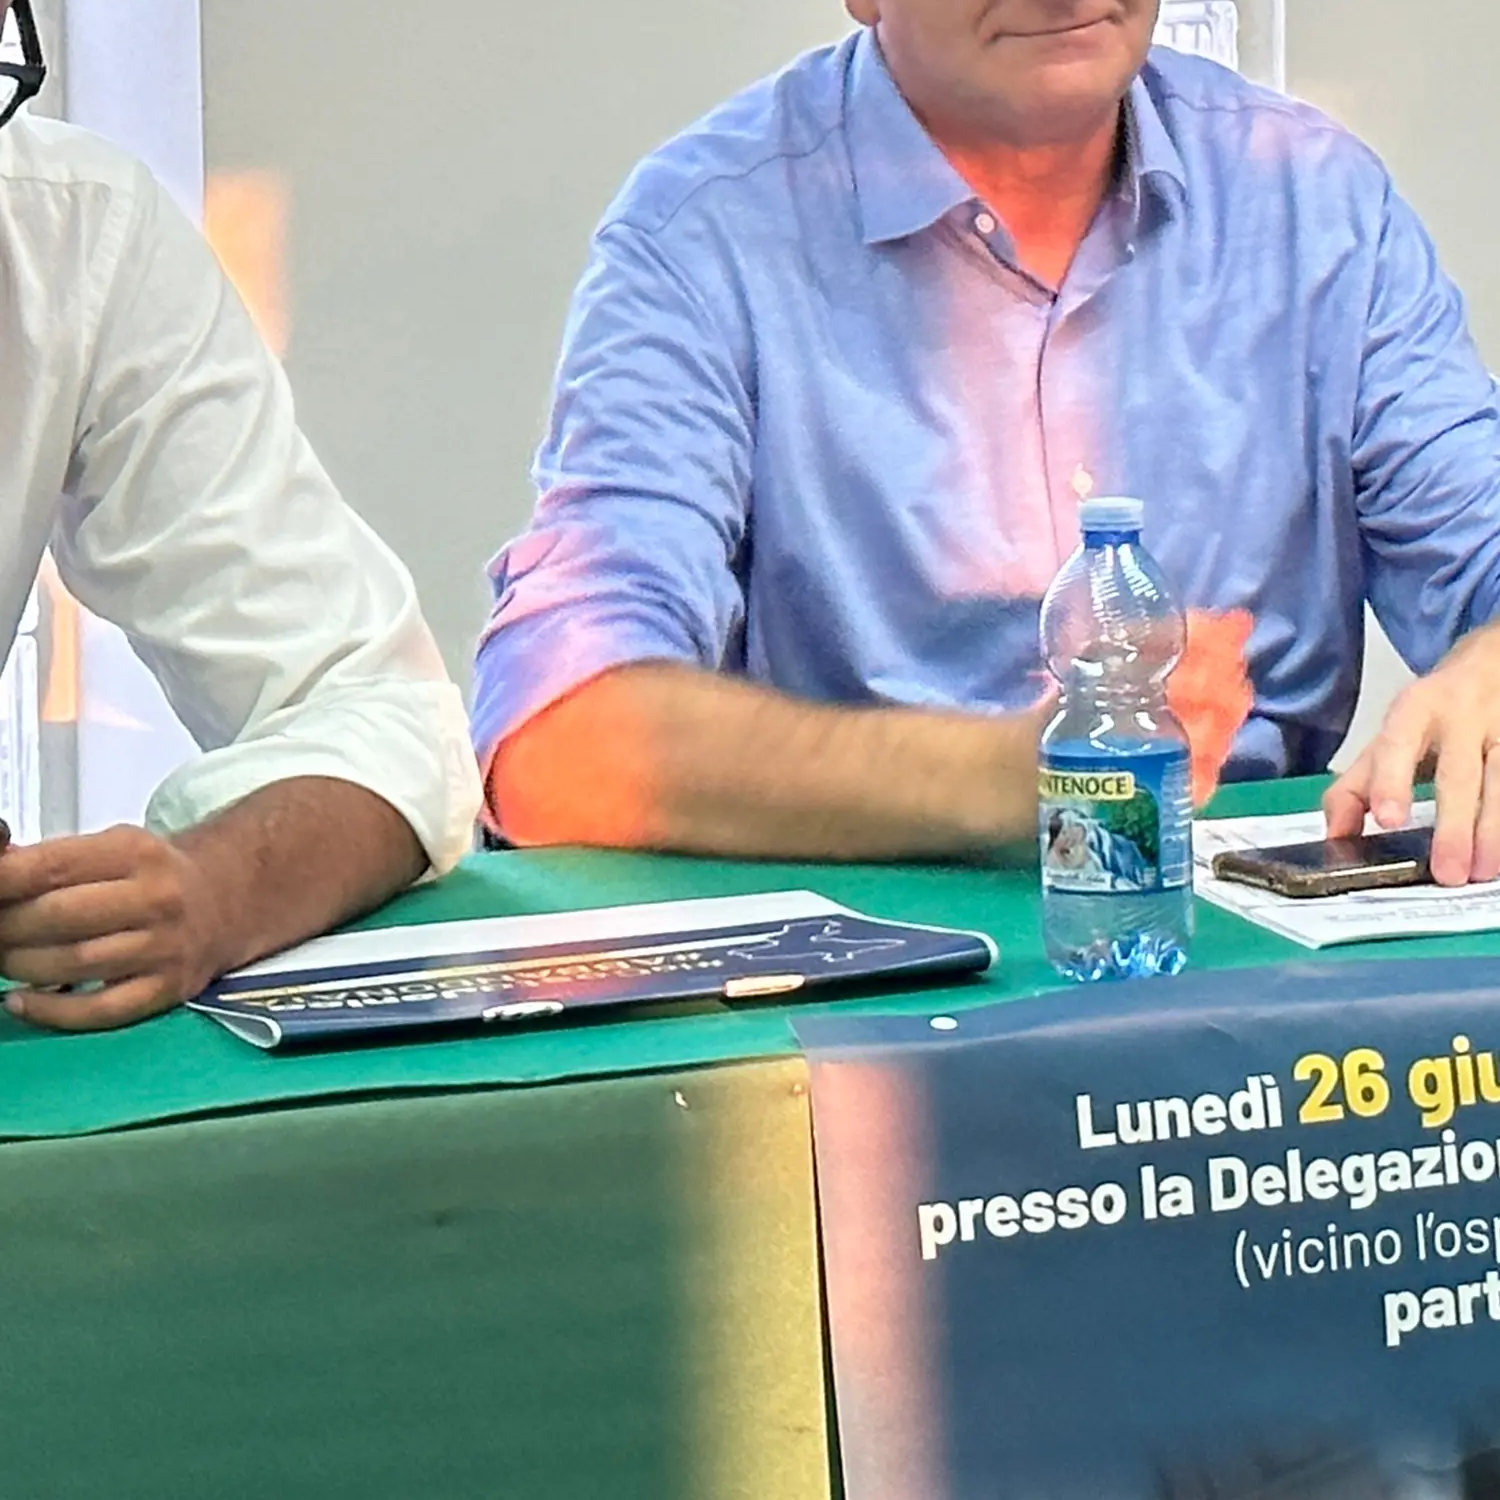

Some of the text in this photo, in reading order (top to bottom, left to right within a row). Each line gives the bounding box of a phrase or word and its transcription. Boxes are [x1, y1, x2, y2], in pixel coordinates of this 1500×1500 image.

[1076, 1074, 1283, 1150] Lunedì
[1293, 1047, 1390, 1125] 26
[918, 1181, 1127, 1260] presso
[1141, 1164, 1194, 1221] la
[1234, 1224, 1402, 1288] (vicino
